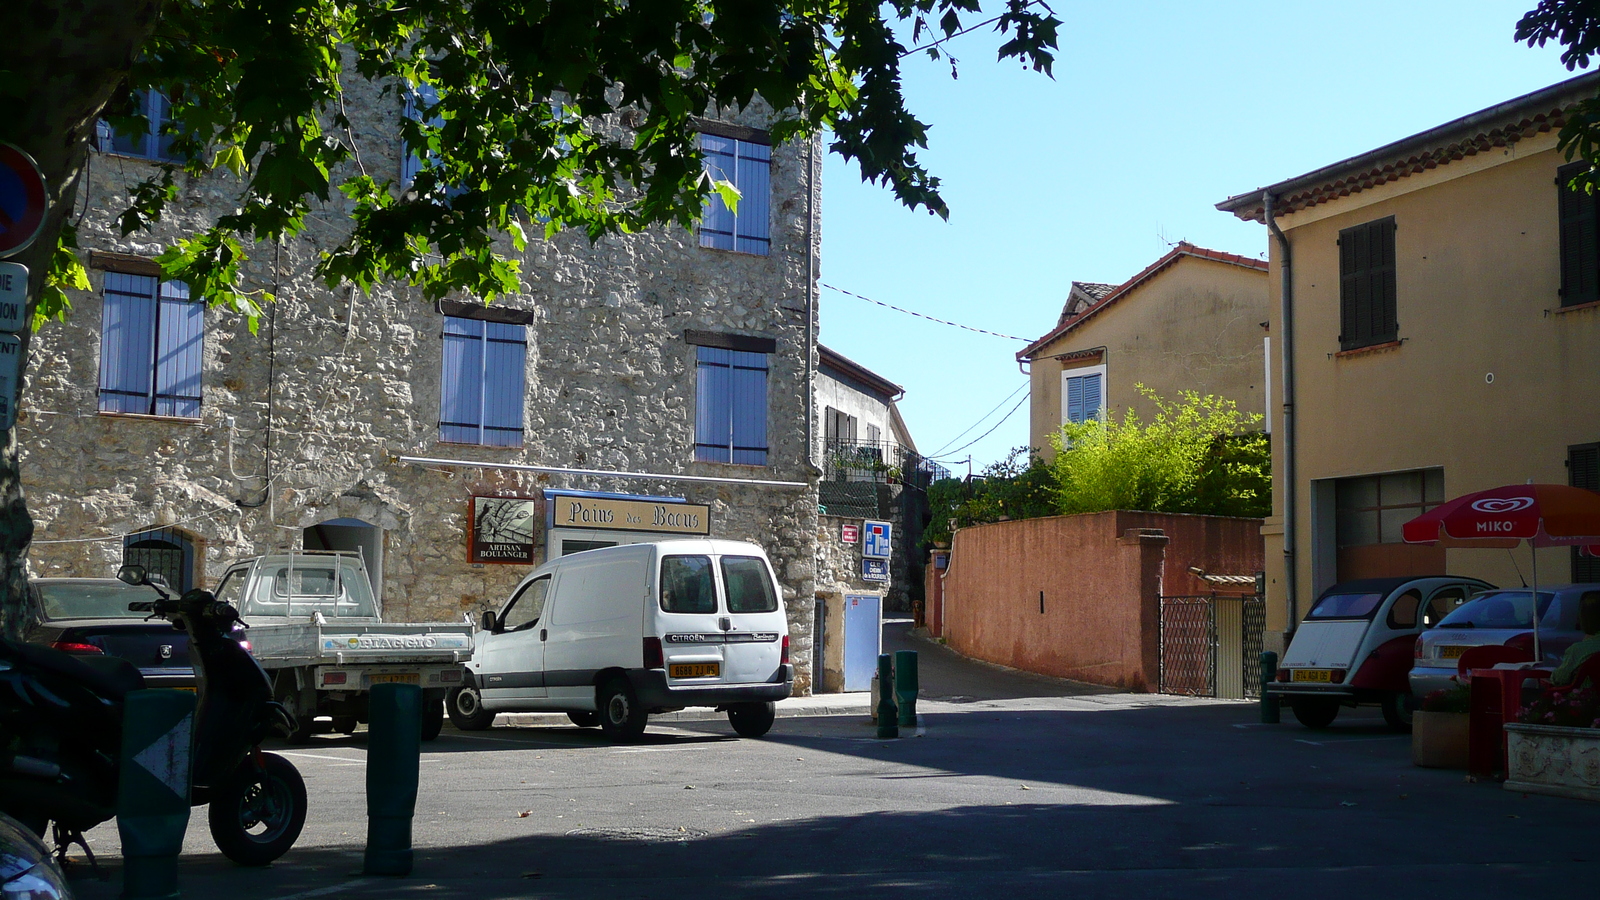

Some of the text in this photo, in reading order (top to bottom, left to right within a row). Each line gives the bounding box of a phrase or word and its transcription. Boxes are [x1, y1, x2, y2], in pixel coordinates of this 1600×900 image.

[568, 502, 614, 523] Pains
[626, 513, 641, 523] des
[1476, 521, 1513, 532] MIKO
[480, 551, 528, 559] BOULANGER
[359, 637, 437, 650] PIAGGIO
